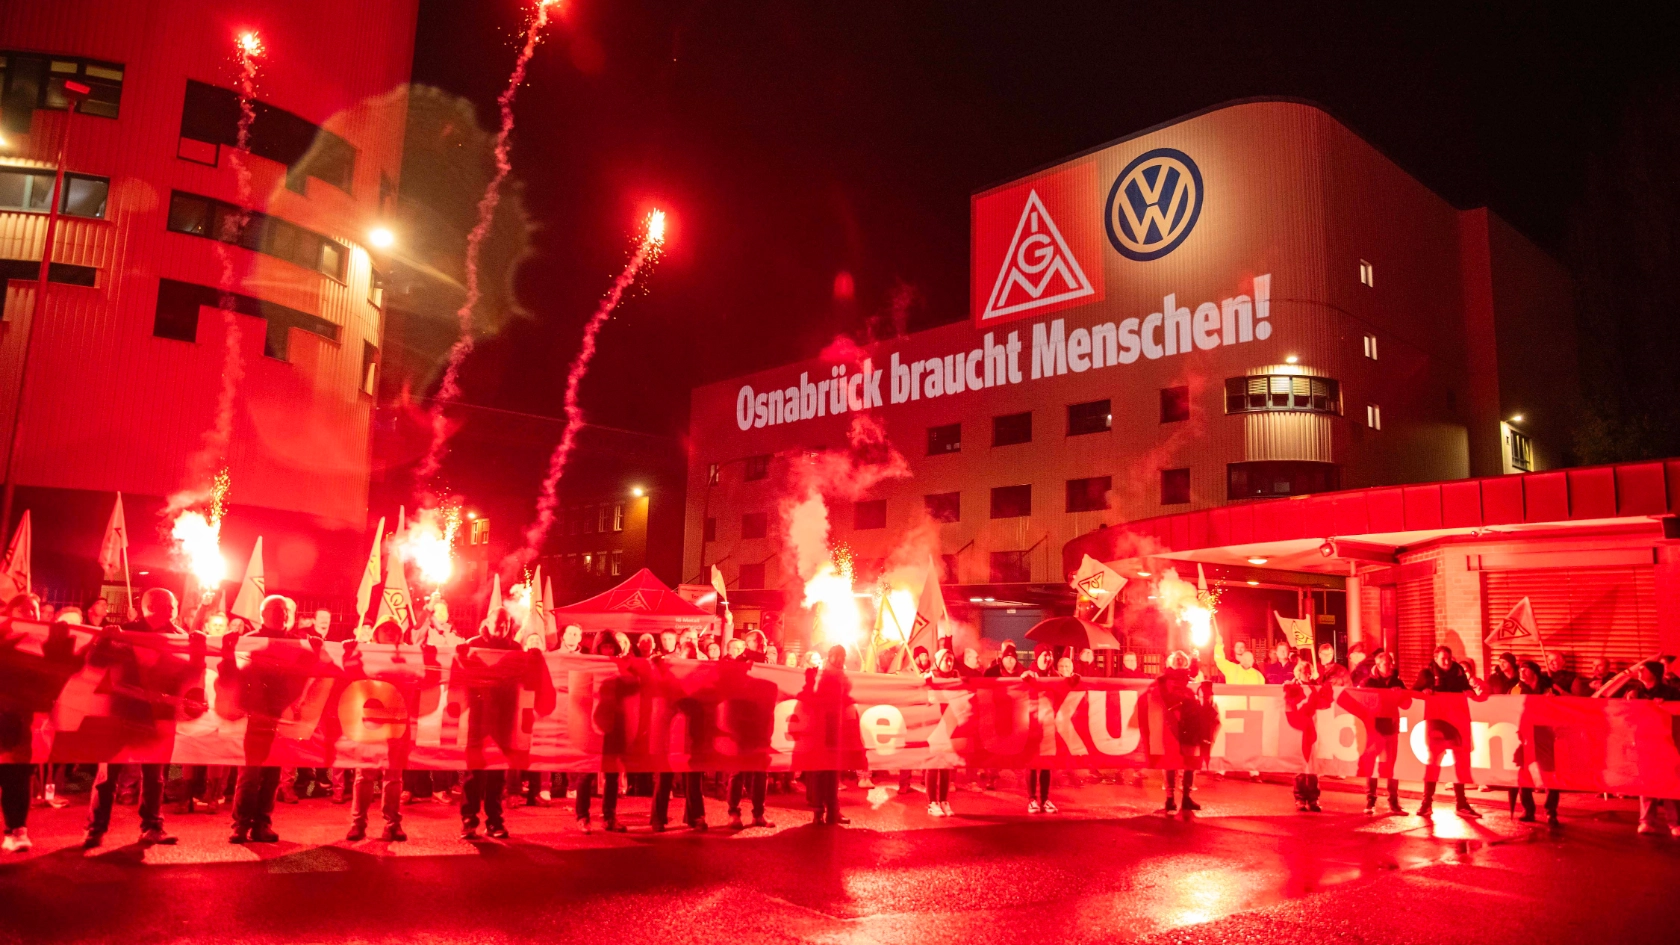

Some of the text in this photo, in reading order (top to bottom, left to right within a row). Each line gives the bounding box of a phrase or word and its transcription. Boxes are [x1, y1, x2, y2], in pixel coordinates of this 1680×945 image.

[1112, 157, 1196, 253] VW
[737, 273, 1272, 431] Osnabrück braucht Menschen!
